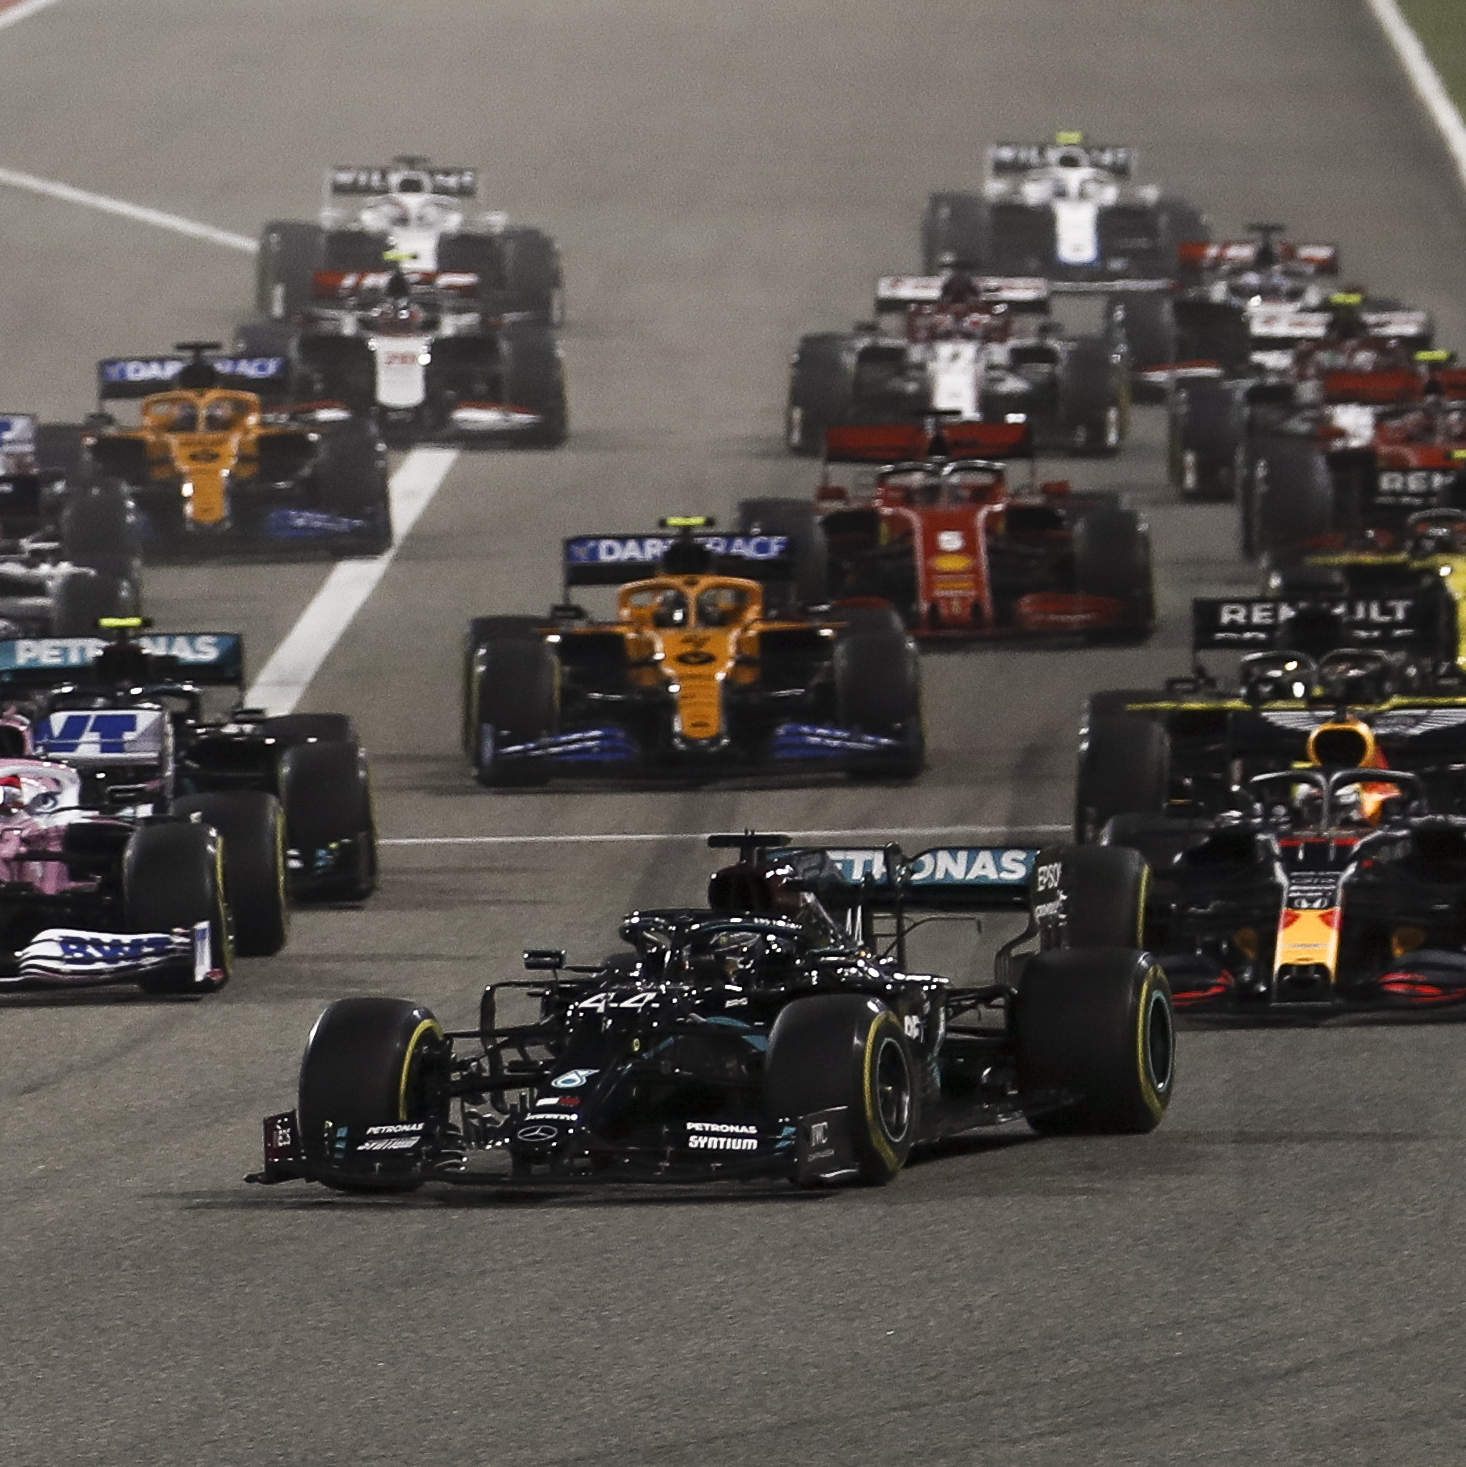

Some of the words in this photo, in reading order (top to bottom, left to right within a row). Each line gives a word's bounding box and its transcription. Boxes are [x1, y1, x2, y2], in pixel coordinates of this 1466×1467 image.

[578, 991, 661, 1014] 44
[365, 1122, 425, 1135] PETRONAS
[686, 1121, 758, 1135] PETRONAS
[688, 1134, 758, 1151] SYNTIUM
